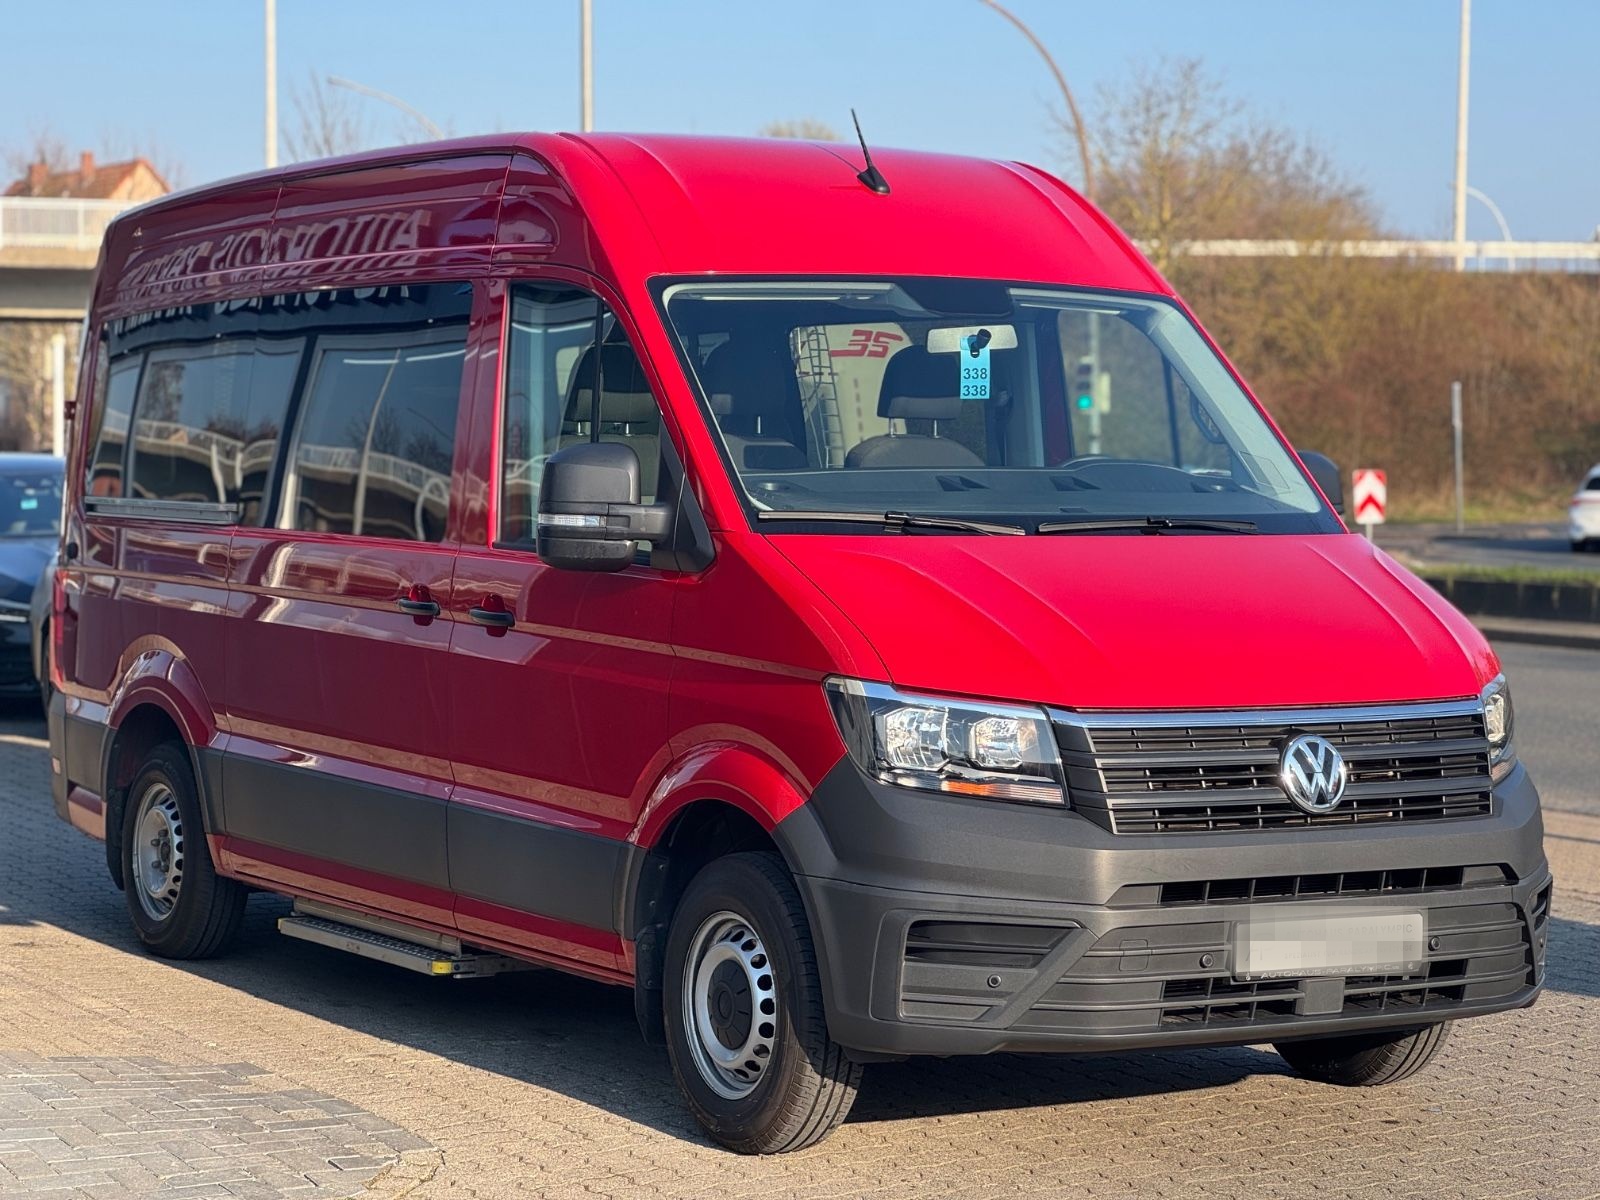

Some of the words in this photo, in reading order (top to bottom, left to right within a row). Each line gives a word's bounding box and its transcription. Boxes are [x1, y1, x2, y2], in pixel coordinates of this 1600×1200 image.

[963, 367, 987, 380] 338
[962, 384, 987, 397] 338
[1284, 737, 1343, 809] VW
